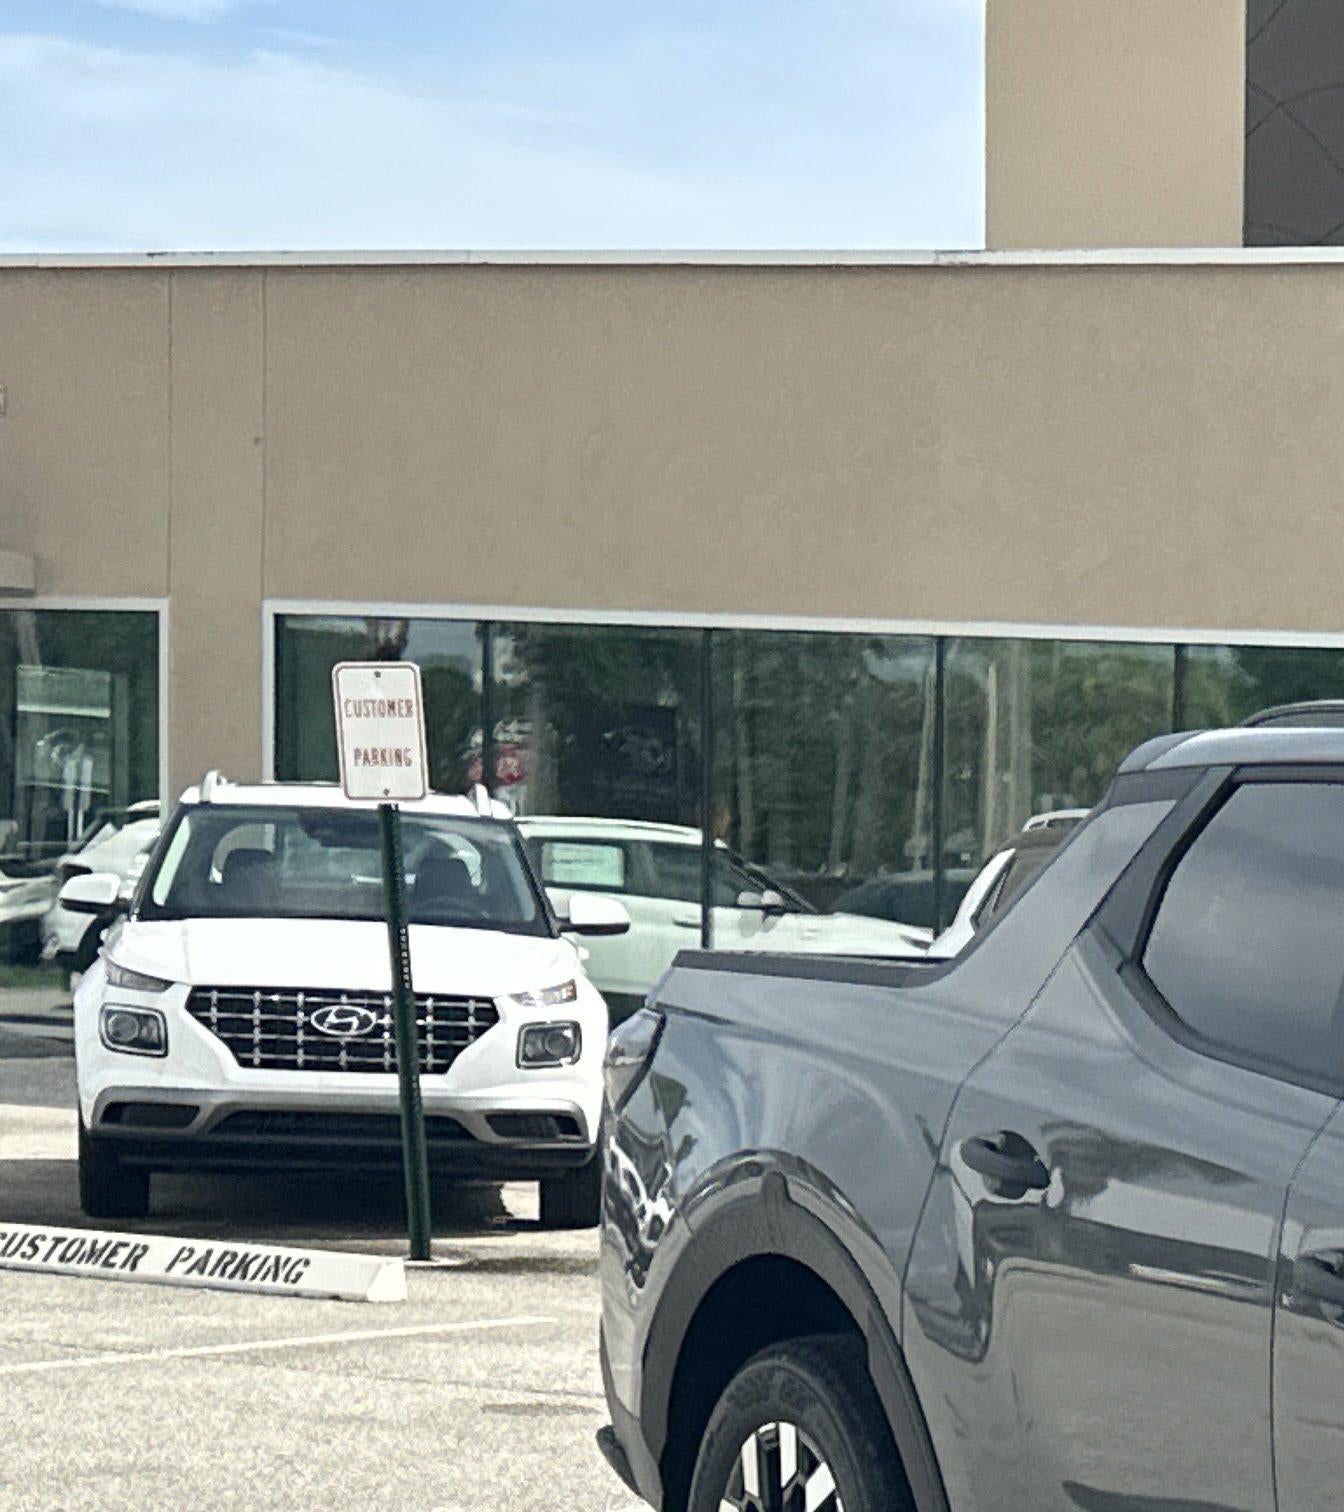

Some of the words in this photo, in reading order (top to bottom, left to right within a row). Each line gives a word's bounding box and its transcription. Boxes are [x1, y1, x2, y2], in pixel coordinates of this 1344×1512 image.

[344, 698, 413, 718] CUSTOMER
[354, 747, 413, 768] PARKING
[164, 1246, 311, 1285] PARKING
